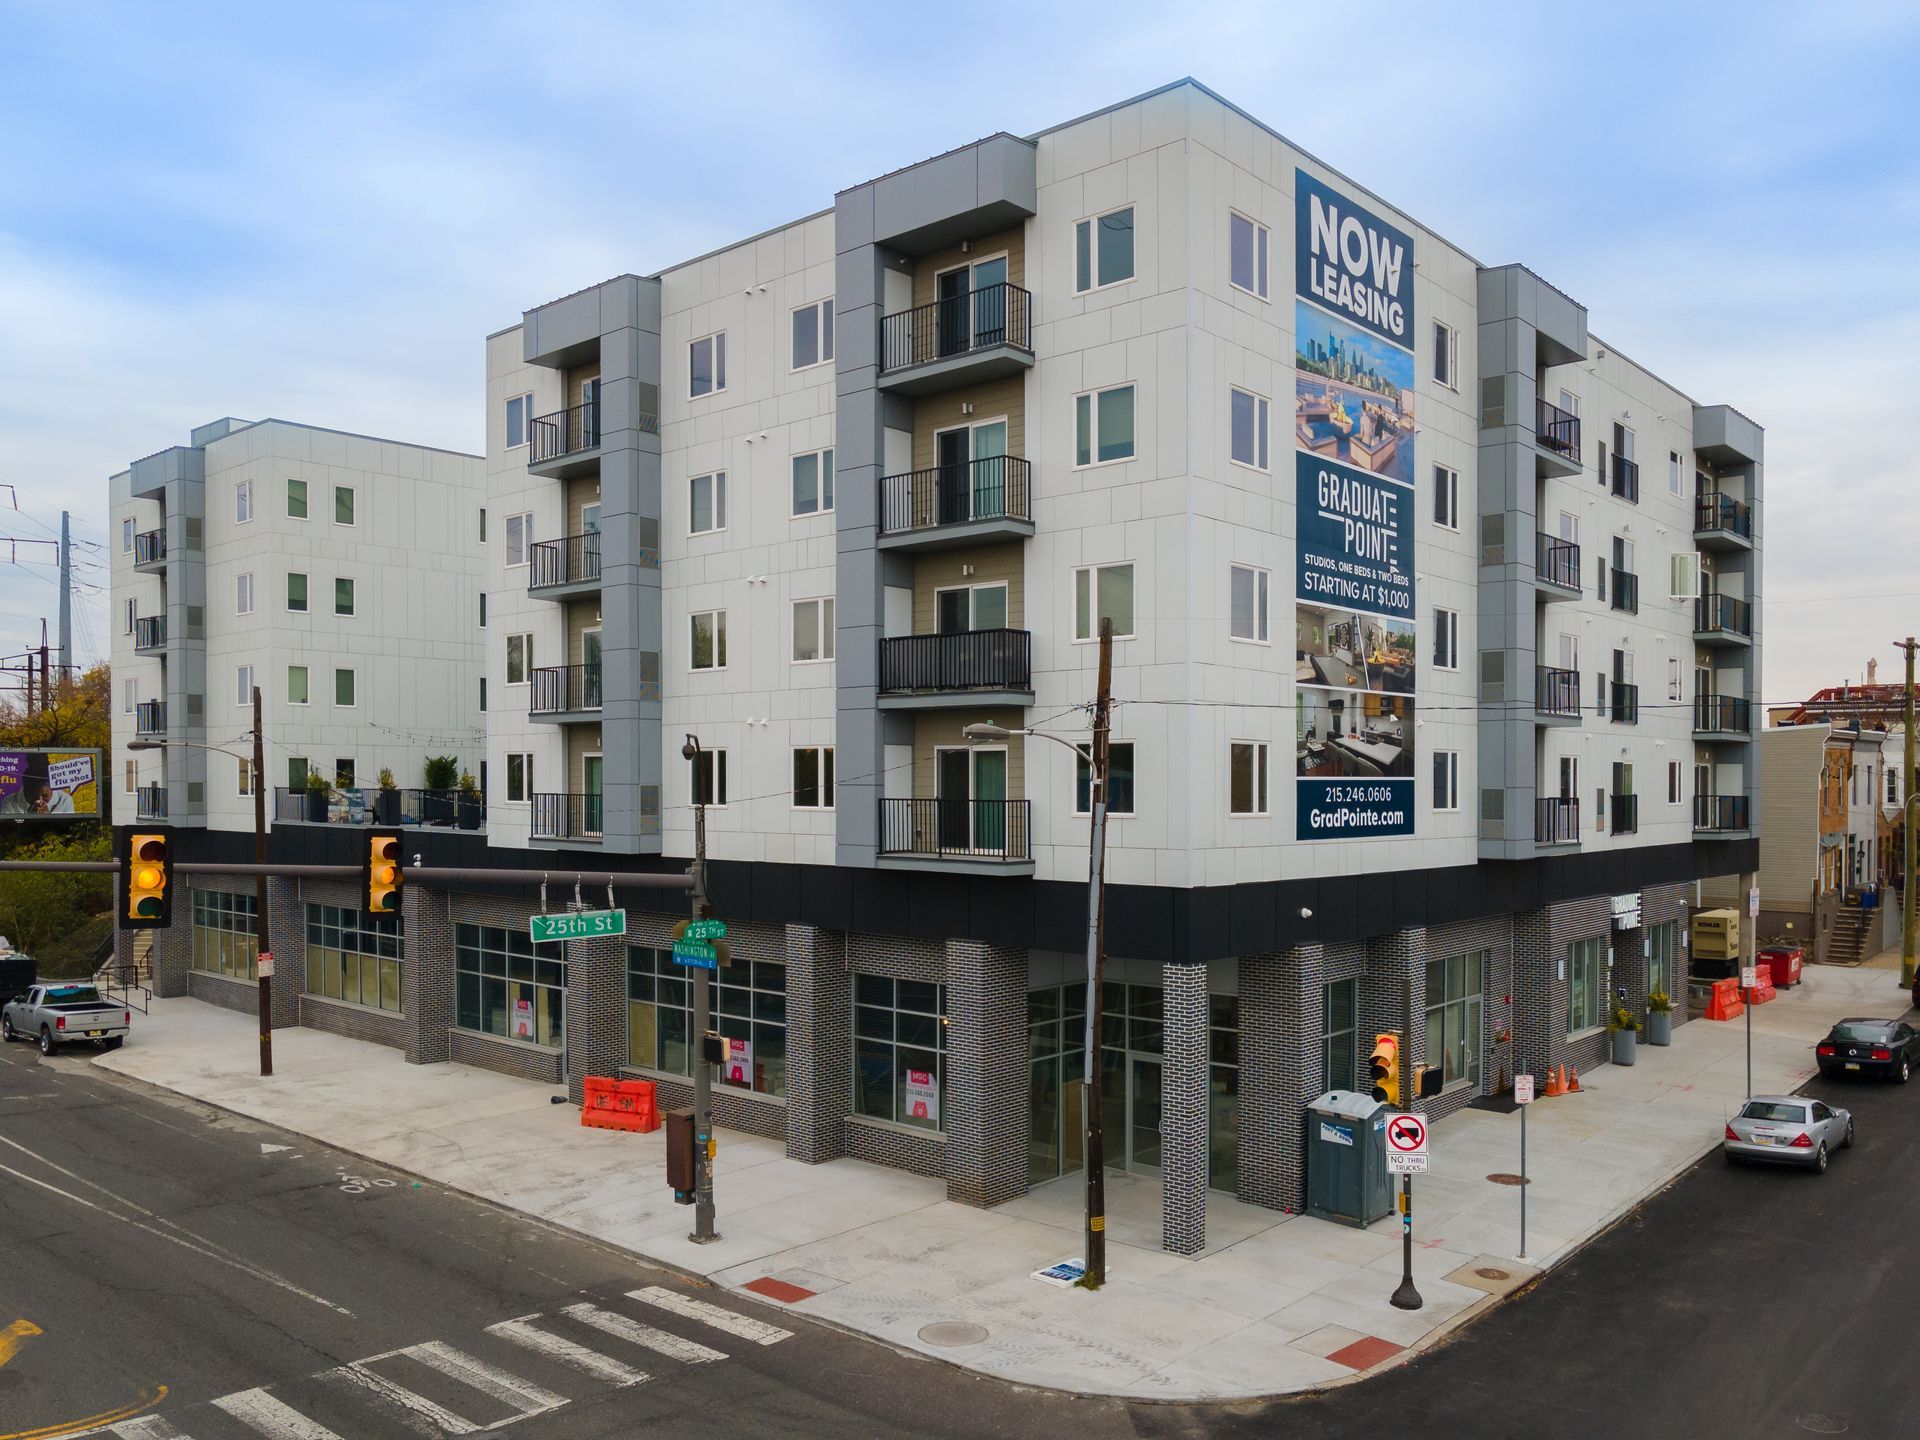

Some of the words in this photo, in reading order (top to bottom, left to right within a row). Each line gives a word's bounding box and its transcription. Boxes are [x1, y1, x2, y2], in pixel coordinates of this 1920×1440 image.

[1310, 193, 1404, 298] NOW
[1310, 257, 1404, 336] LEASING
[1318, 470, 1397, 528] GRADUATE
[1345, 517, 1397, 565] POINTE
[1304, 553, 1337, 571] STUDIOS,
[1338, 561, 1353, 574] ONE
[1354, 564, 1371, 577] BEDS
[1372, 569, 1377, 580] &
[1378, 570, 1392, 583] TWO
[1393, 574, 1409, 587] BEDS
[1304, 571, 1360, 599] STARTING
[1362, 584, 1376, 602] AT
[1378, 585, 1409, 609] $1,000
[49, 759, 90, 772] Should've
[51, 771, 66, 780] got
[68, 767, 82, 775] my
[54, 777, 68, 786] flu
[70, 774, 90, 783] shot
[1326, 787, 1392, 802] 215.246.0606
[1310, 808, 1404, 828] GradPointe.com
[545, 919, 587, 935] 25th
[595, 917, 613, 931] St
[1390, 1155, 1404, 1164] NO
[1395, 1164, 1421, 1172] TRUCKS
